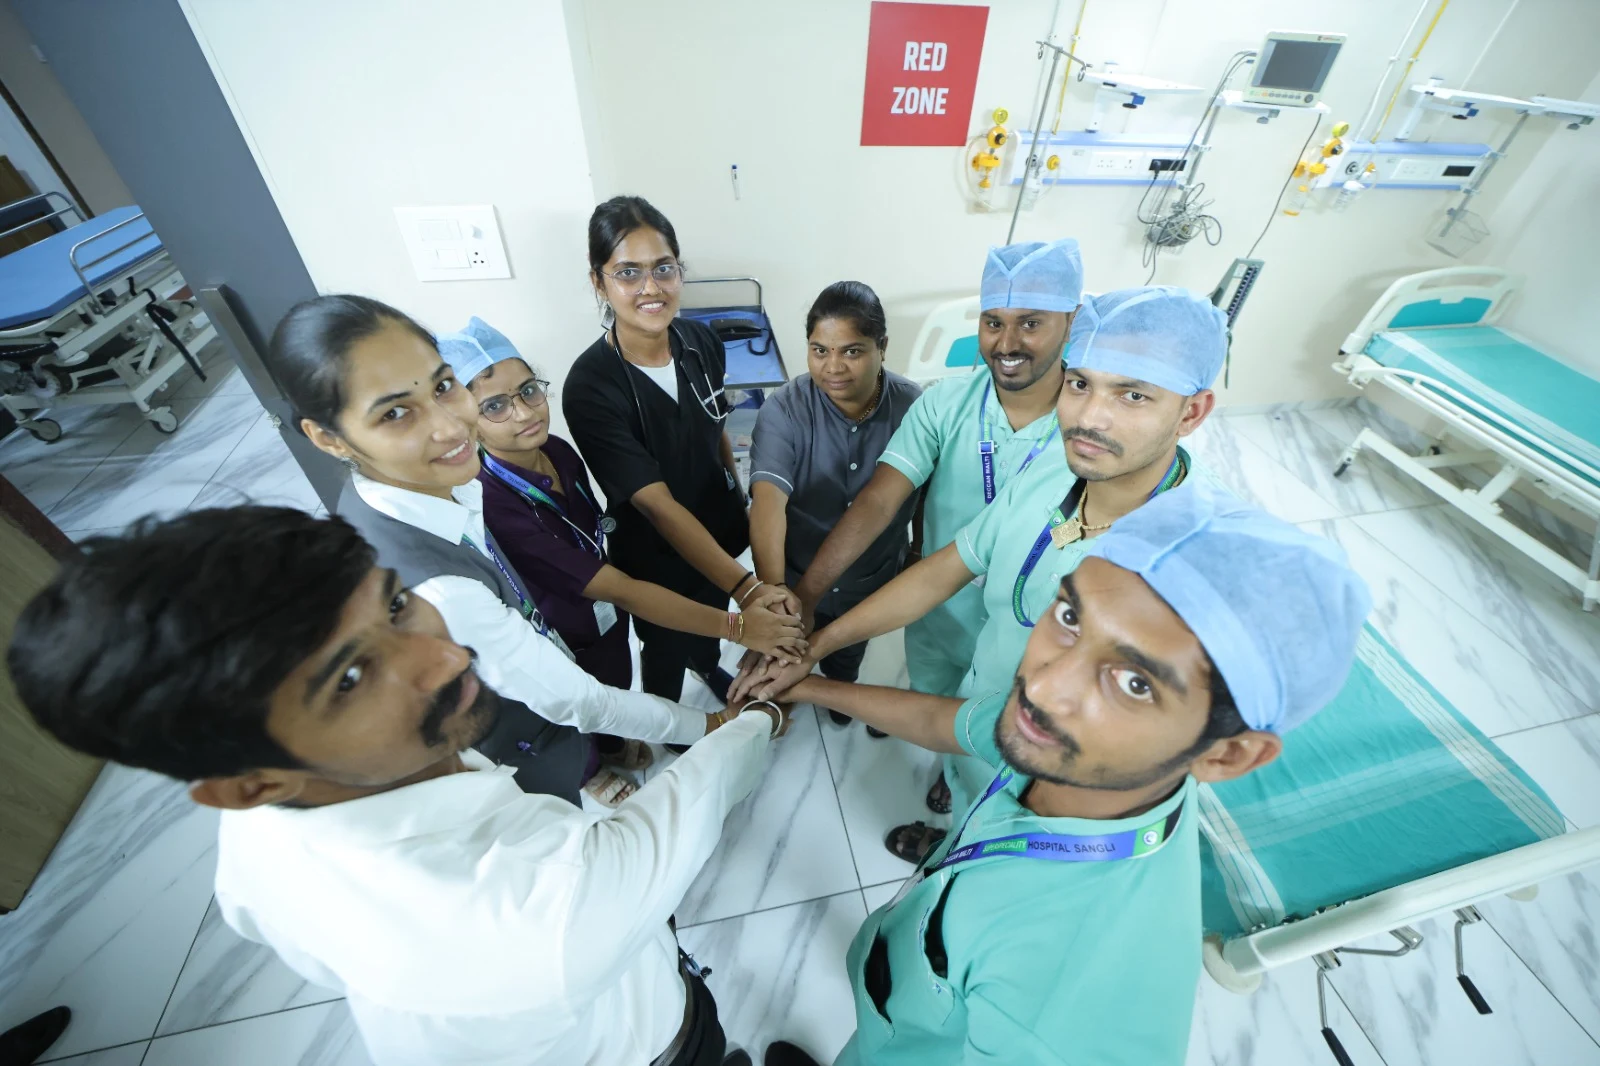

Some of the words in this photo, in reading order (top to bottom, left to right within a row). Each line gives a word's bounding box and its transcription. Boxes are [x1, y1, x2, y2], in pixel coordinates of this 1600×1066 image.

[903, 41, 948, 71] RED
[890, 86, 949, 115] ZONE
[1028, 841, 1071, 853] HOSPITAL
[1074, 842, 1116, 854] SANGLI
